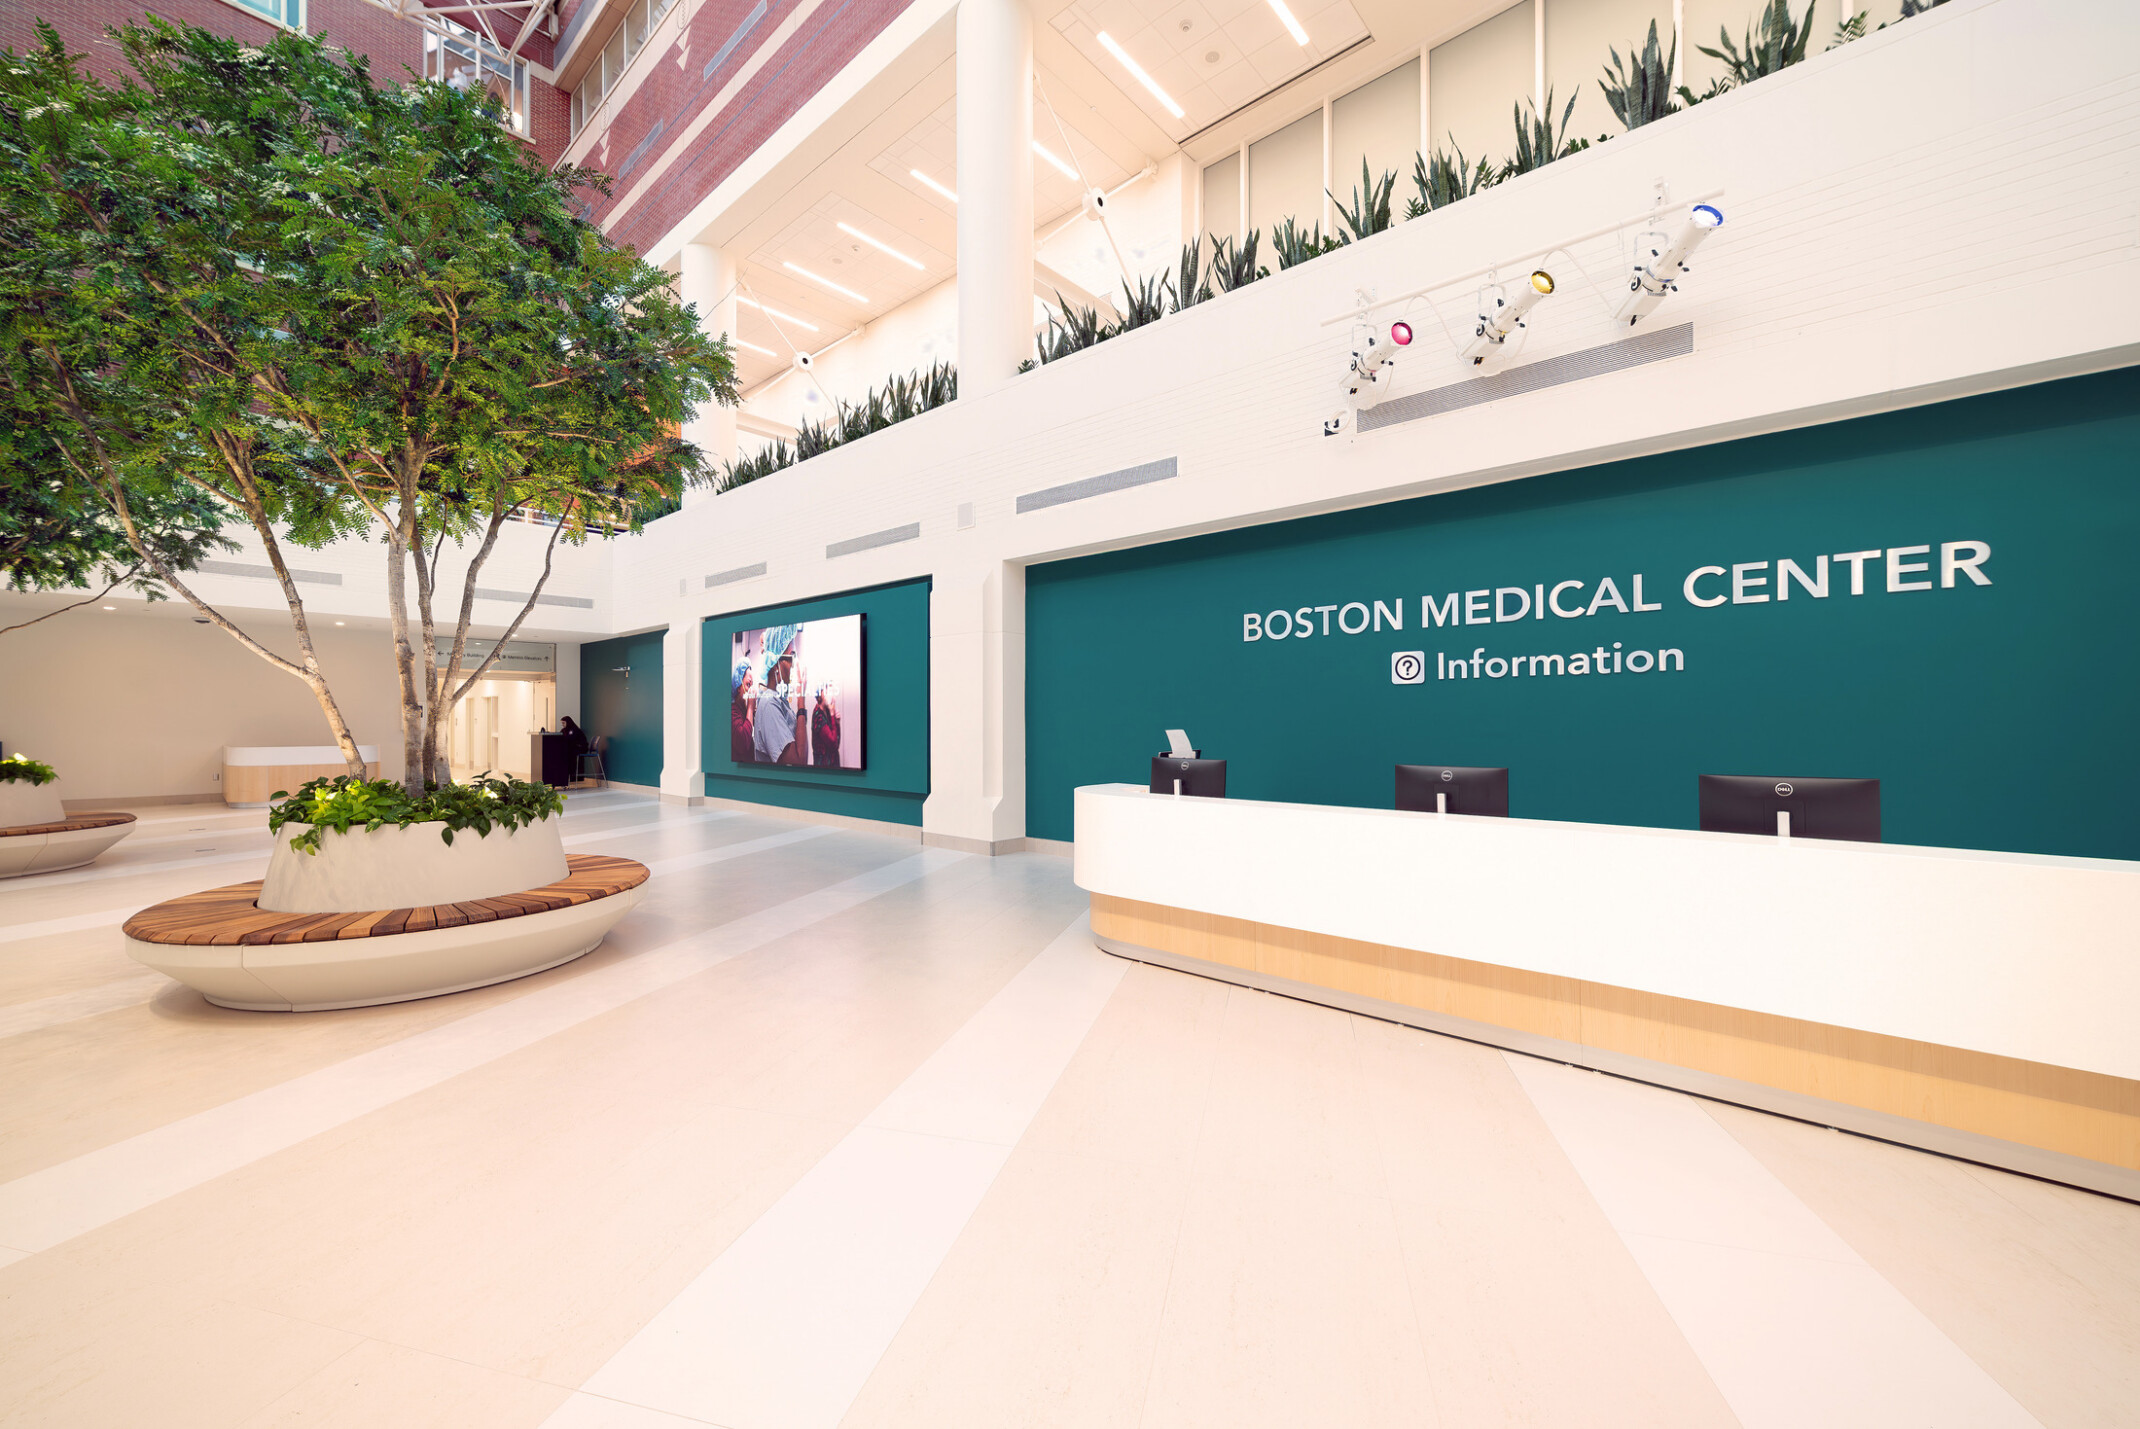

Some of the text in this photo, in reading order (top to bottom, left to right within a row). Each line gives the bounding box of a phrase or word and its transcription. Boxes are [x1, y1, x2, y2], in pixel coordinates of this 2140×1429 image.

[1243, 540, 1993, 642] BOSTON MEDICAL CENTER
[1438, 642, 1685, 680] Information
[776, 680, 840, 698] SPECIALTIES
